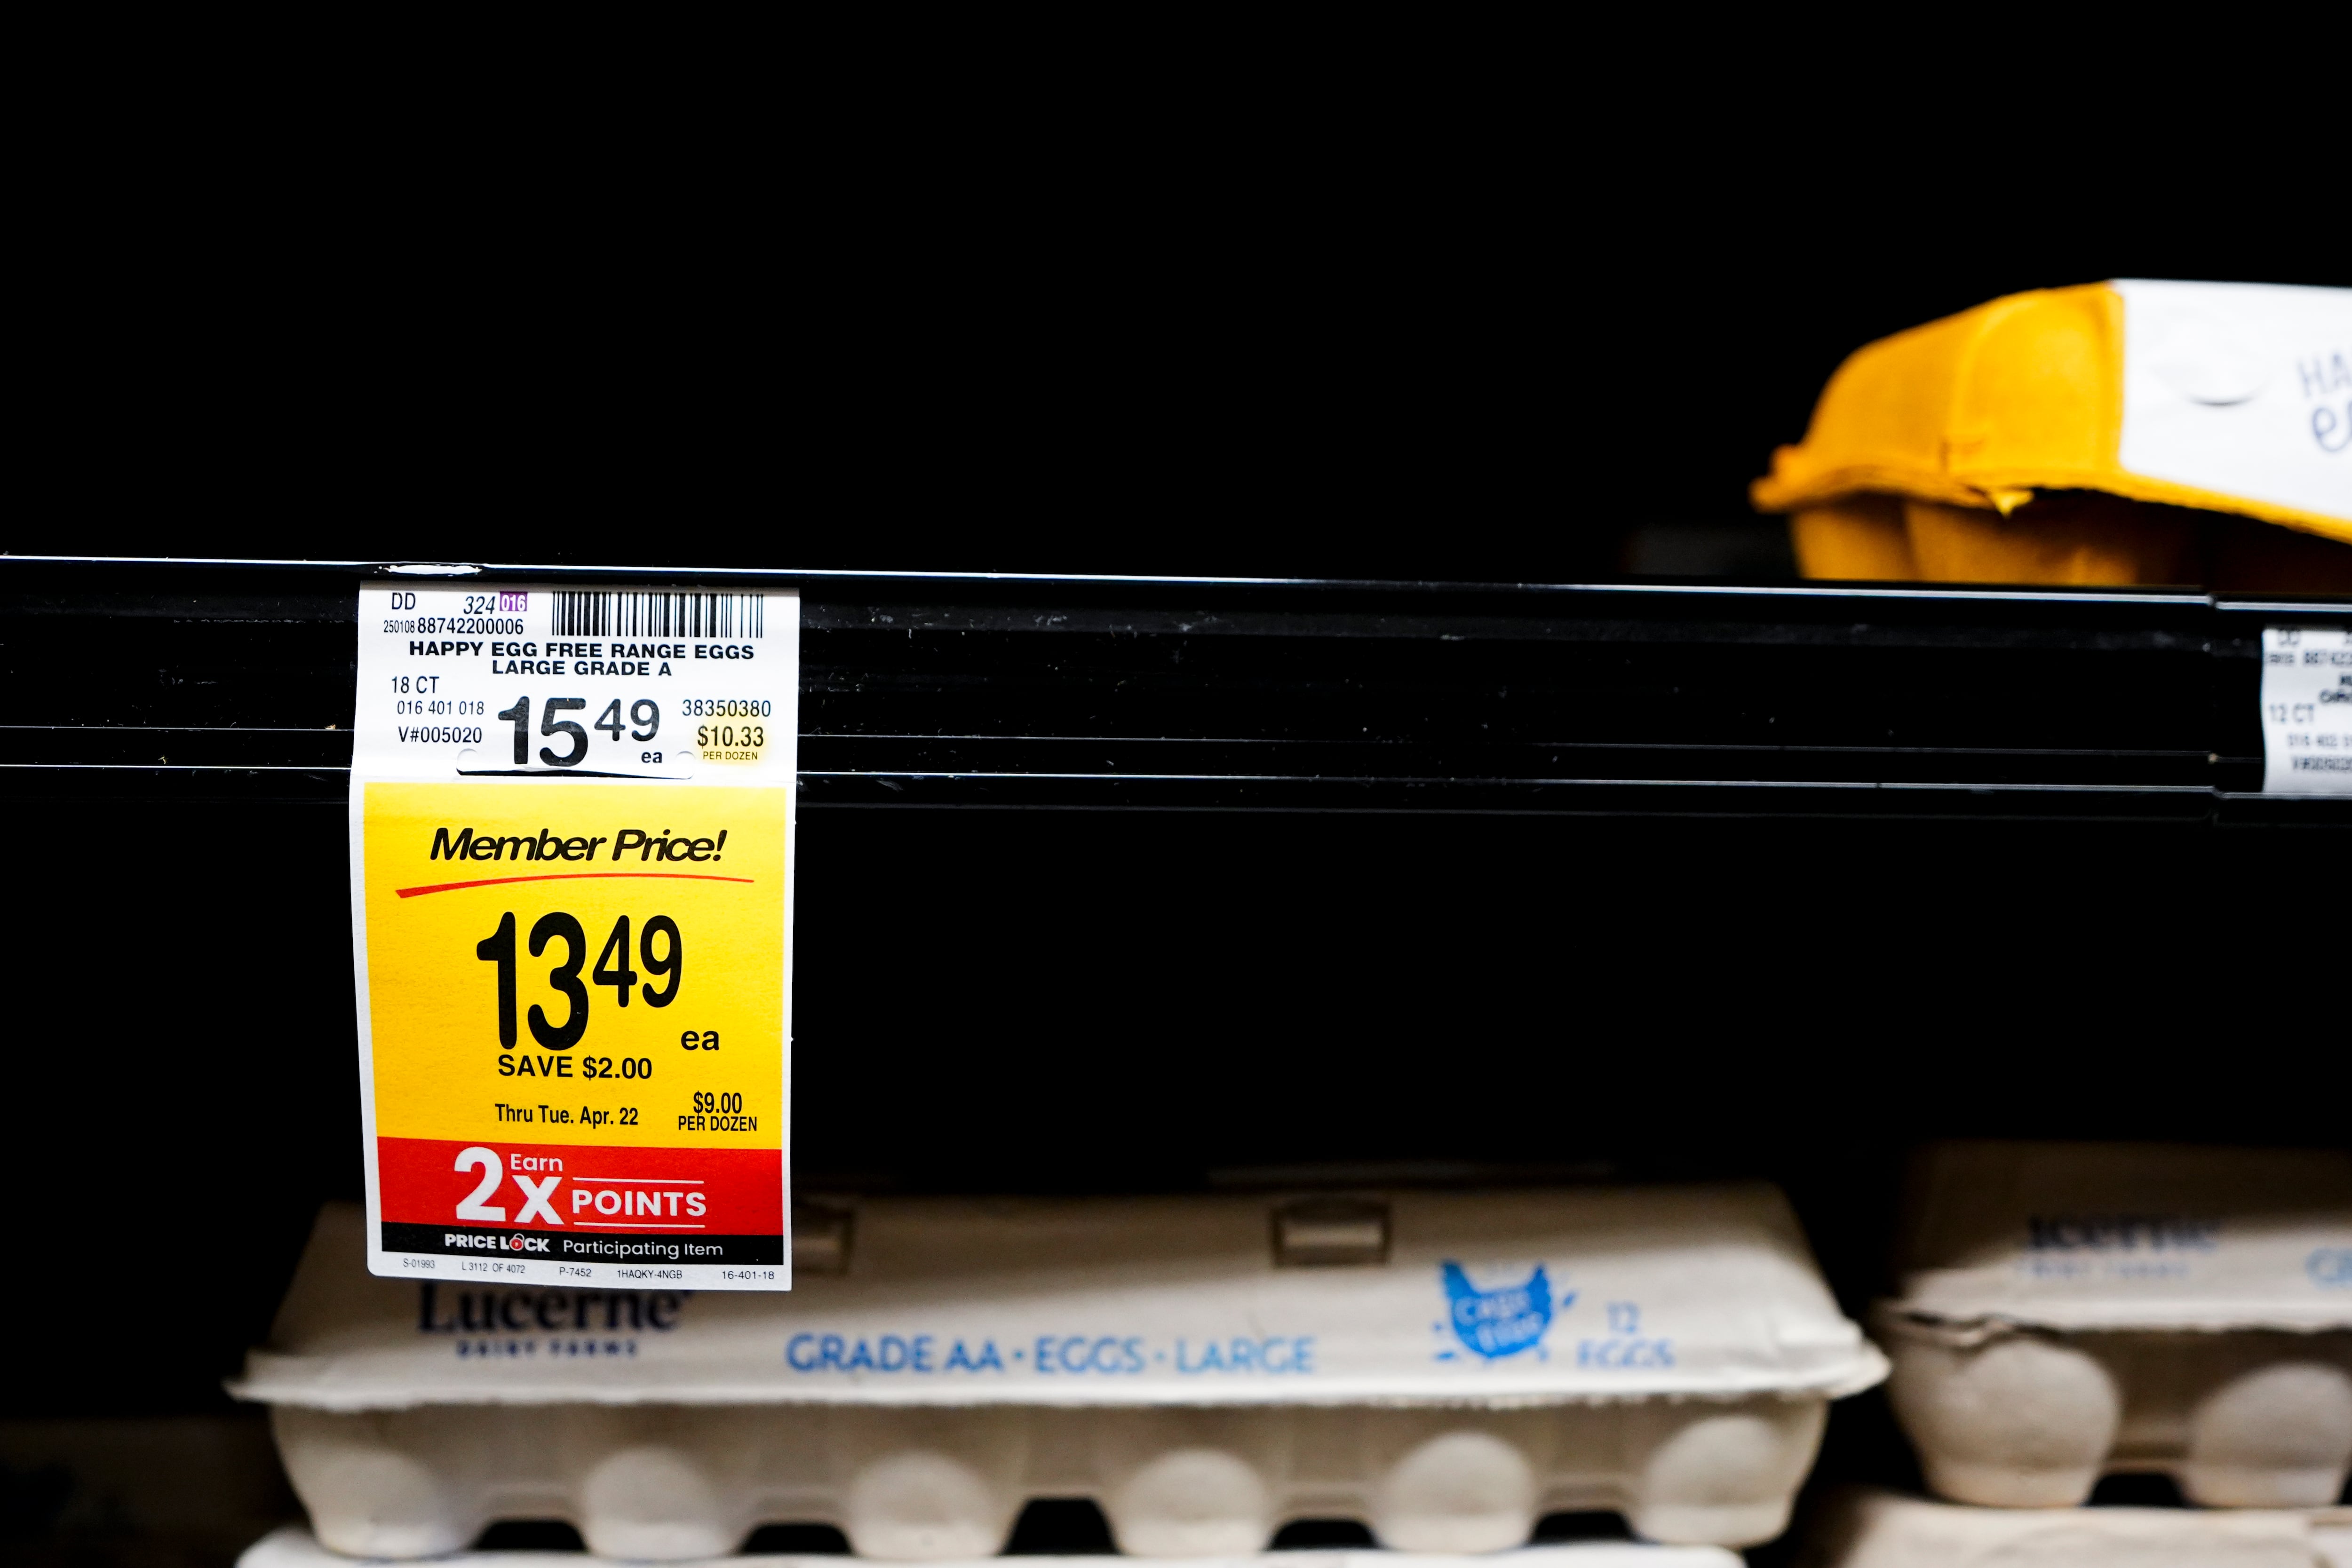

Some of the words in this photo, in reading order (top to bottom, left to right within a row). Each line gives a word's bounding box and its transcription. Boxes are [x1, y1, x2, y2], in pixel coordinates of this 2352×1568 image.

[391, 592, 416, 610] DD
[463, 596, 495, 615] 324
[501, 594, 526, 612] 016
[383, 620, 415, 633] 250108
[417, 617, 524, 635] 88742200006
[410, 641, 484, 656] HAPPY
[492, 642, 537, 657] EGG
[546, 642, 602, 657] FREE
[611, 643, 686, 658] RANGE
[695, 645, 754, 659] EGGS
[493, 660, 565, 675] LARGE
[574, 661, 650, 676] GRADE
[658, 662, 672, 676] A
[392, 676, 409, 694] 18
[416, 676, 439, 694] CT
[397, 700, 422, 714] 016
[428, 700, 452, 715] 401
[459, 701, 484, 715] 018
[682, 699, 771, 717] 38350380
[398, 726, 482, 744] V#005020
[697, 725, 764, 748] $10.33
[641, 752, 662, 763] ea
[703, 751, 722, 760] PER
[725, 751, 757, 760] DOZEN
[430, 827, 607, 861] Member
[612, 829, 728, 862] Price!
[681, 1030, 719, 1051] ea
[498, 1054, 573, 1077] SAVE
[582, 1055, 652, 1081] $2.00
[693, 1090, 742, 1116] $9.00
[494, 1103, 533, 1123] Thru
[538, 1105, 574, 1124] Tue.
[580, 1106, 614, 1129] Apr.
[620, 1107, 638, 1125] 22
[678, 1114, 705, 1131] PER
[710, 1116, 757, 1132] DOZEN
[510, 1153, 563, 1172] Earn
[572, 1189, 706, 1216] POINTS
[445, 1234, 496, 1249] PRICE
[564, 1240, 679, 1259] Participating
[684, 1243, 723, 1255] Item
[403, 1258, 435, 1268] S-01993
[462, 1262, 467, 1270] L
[469, 1262, 488, 1272] 3112
[493, 1263, 503, 1272] OF
[506, 1264, 525, 1274] 4072
[559, 1267, 591, 1277] P-7452
[618, 1269, 682, 1279] 1HAQKY-4NGB
[723, 1271, 774, 1280] 16-401-18
[418, 1280, 681, 1333] Lucerne
[786, 1333, 933, 1373] GRADE
[944, 1337, 1004, 1374] AA
[1036, 1336, 1144, 1374] EGGS
[1177, 1336, 1315, 1374] LARGE
